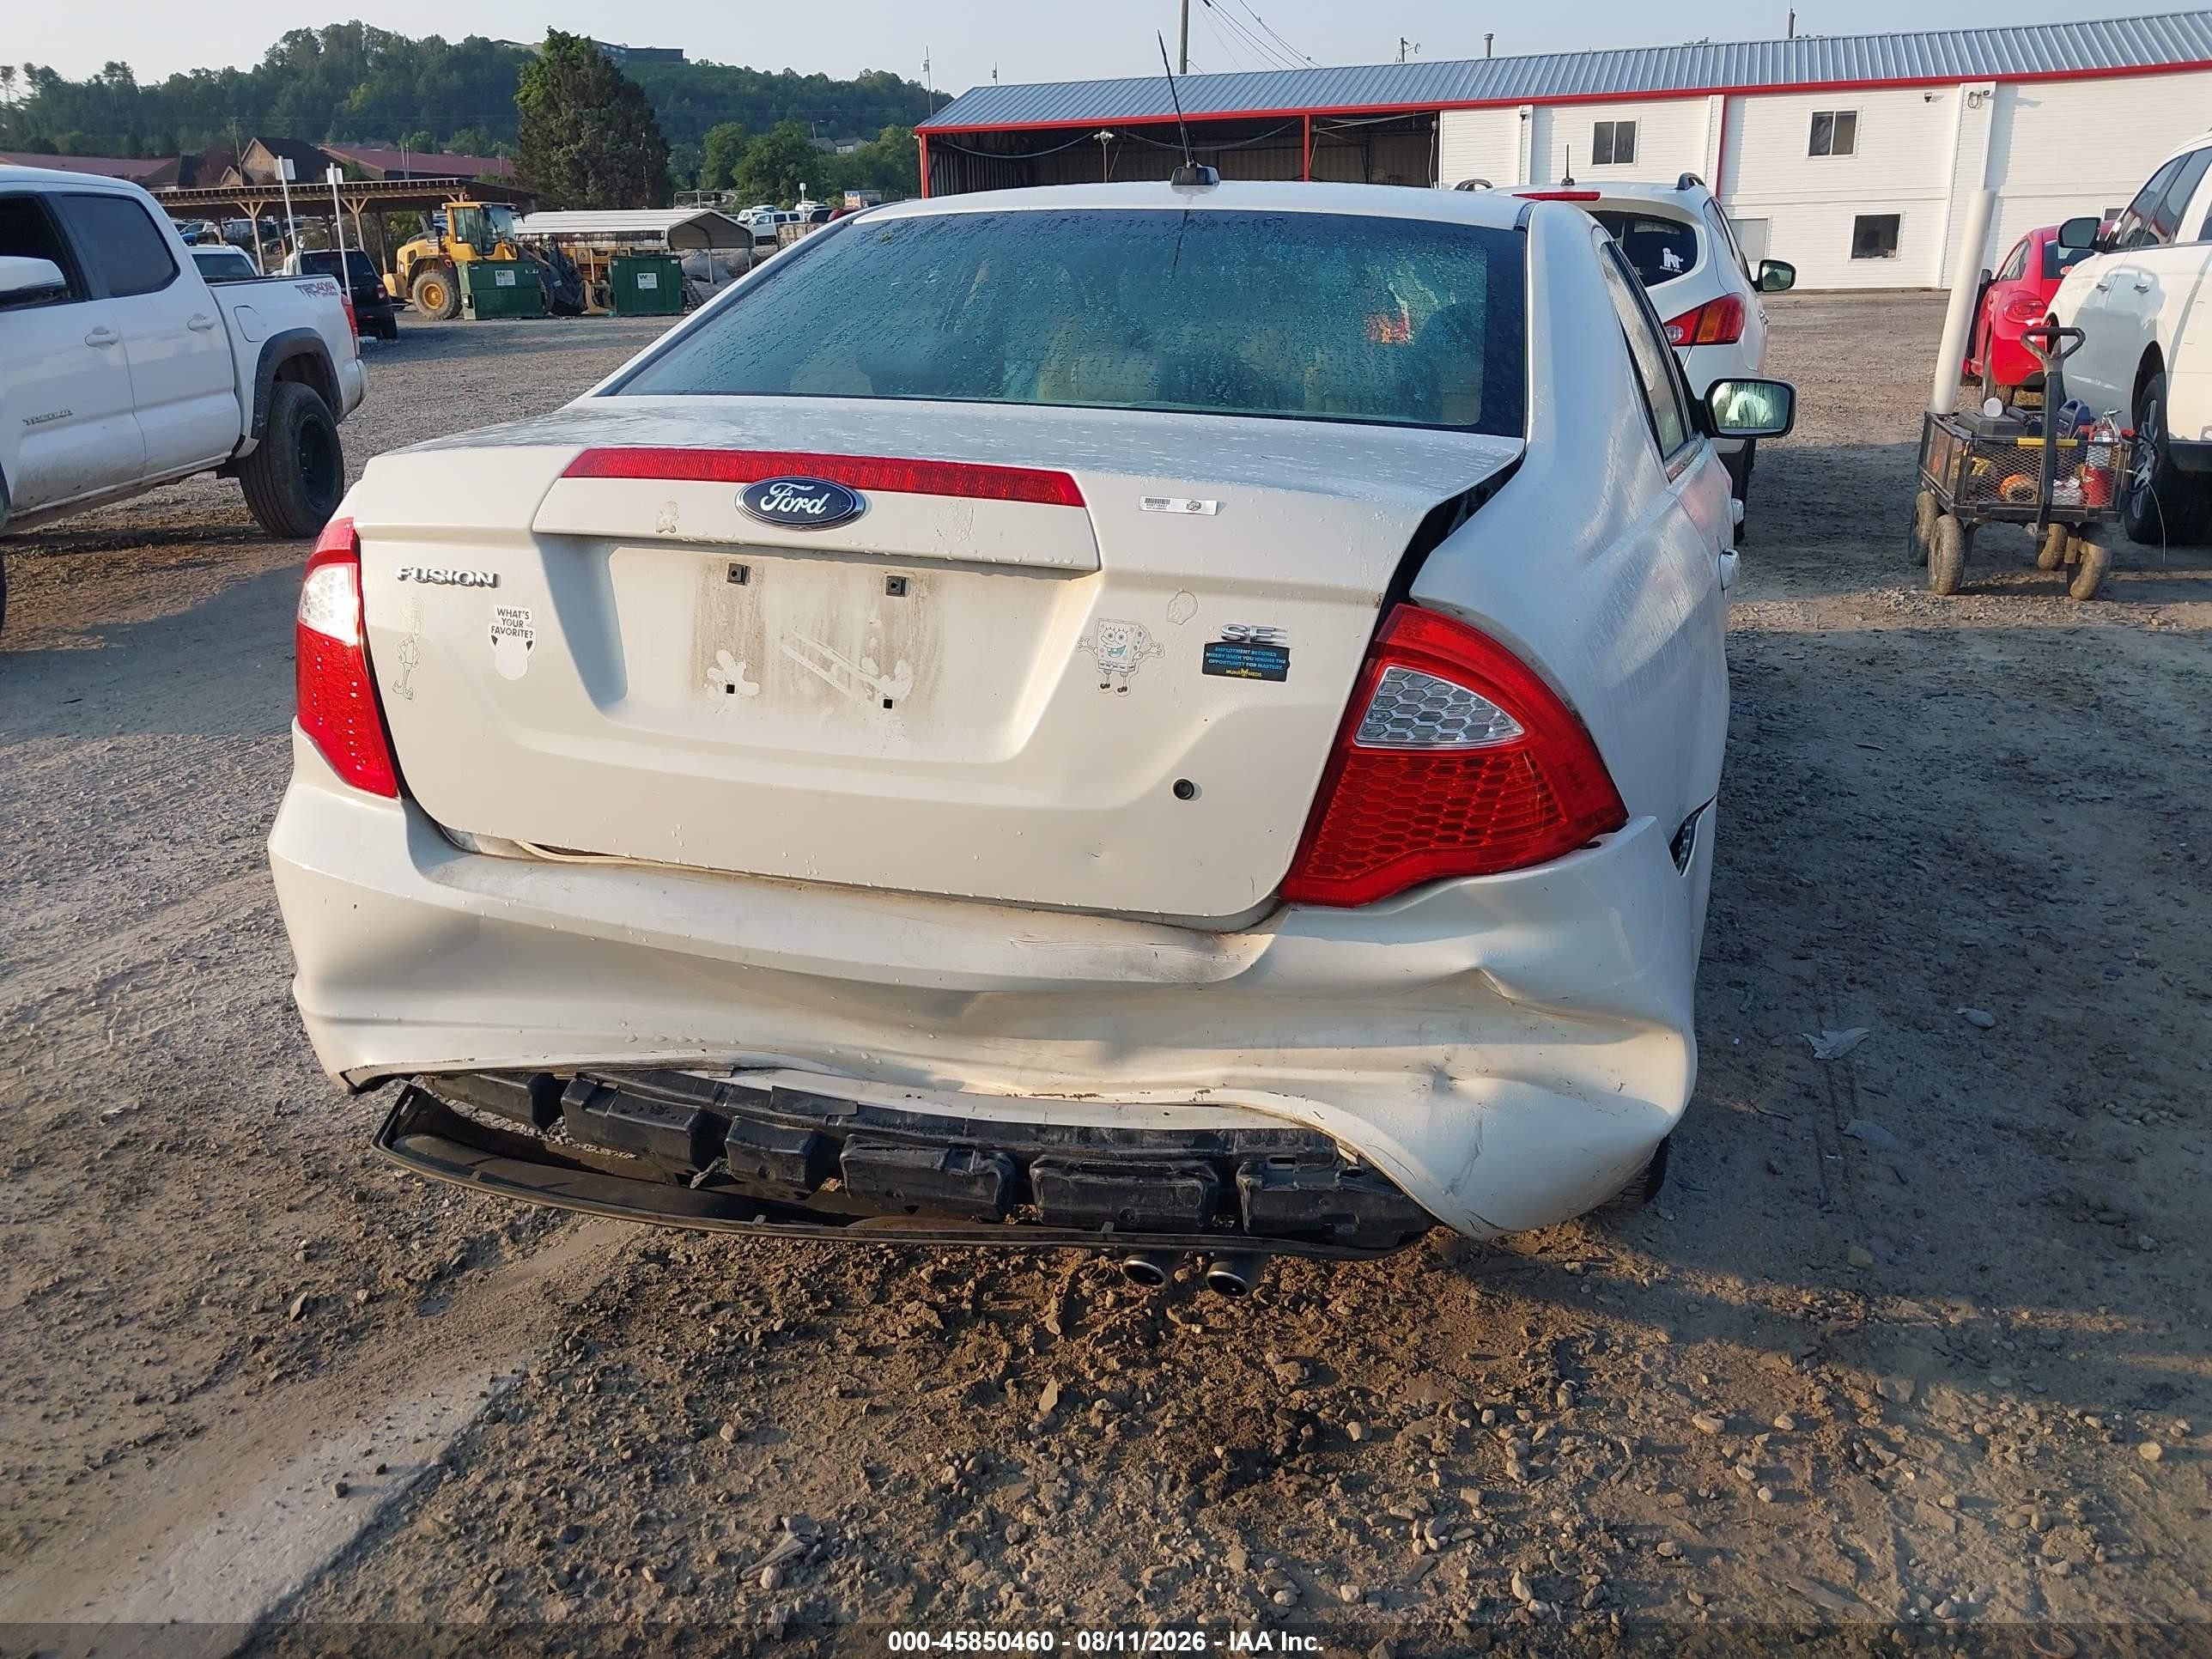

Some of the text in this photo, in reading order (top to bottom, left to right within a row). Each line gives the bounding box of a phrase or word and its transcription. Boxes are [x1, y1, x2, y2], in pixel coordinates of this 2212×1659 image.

[760, 483, 831, 514] Ford
[397, 565, 501, 589] FUSION
[496, 607, 530, 620] WHAT'S
[501, 617, 525, 628] YOUR
[490, 625, 534, 639] FAVORITE?
[1221, 624, 1285, 643] SE
